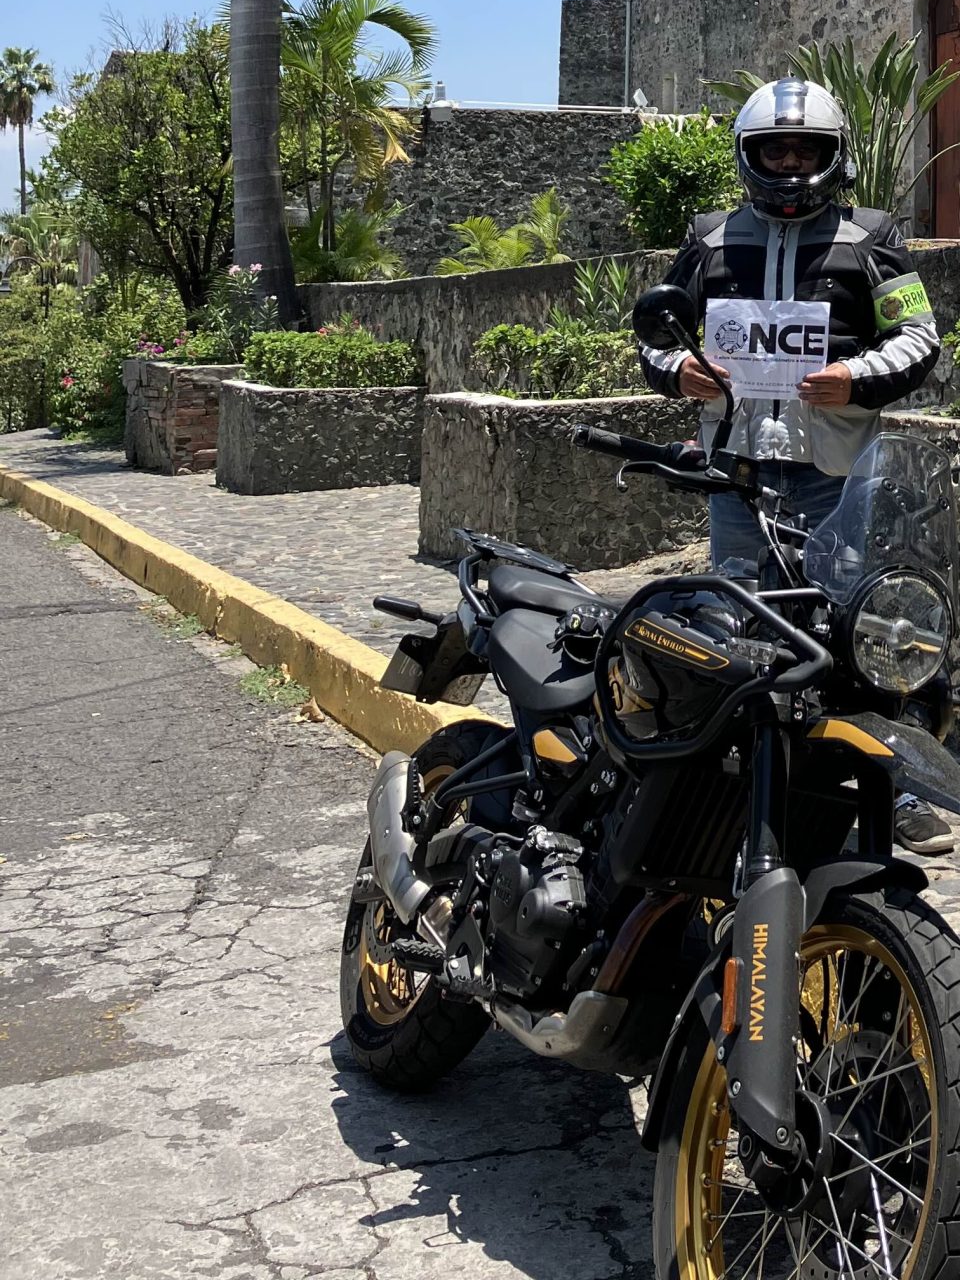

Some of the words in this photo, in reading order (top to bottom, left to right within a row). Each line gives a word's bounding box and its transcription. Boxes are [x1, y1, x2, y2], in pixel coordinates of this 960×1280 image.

[902, 290, 927, 309] RRM
[639, 625, 657, 641] ROYAL
[656, 634, 685, 653] ENFIELD
[749, 923, 769, 1041] HIMALAYAN
